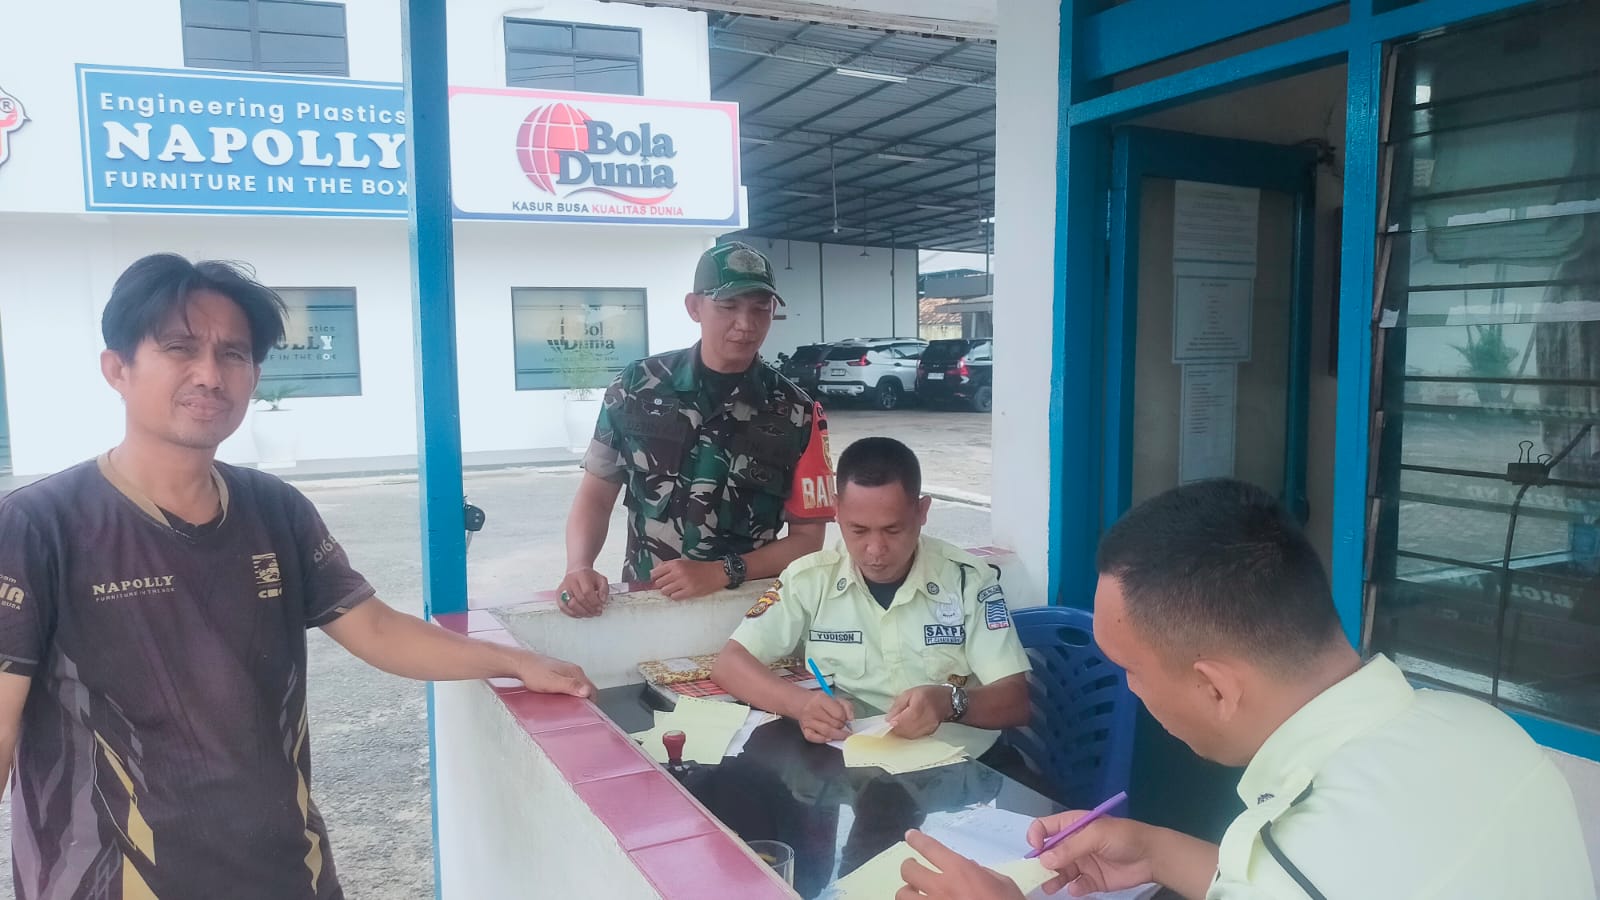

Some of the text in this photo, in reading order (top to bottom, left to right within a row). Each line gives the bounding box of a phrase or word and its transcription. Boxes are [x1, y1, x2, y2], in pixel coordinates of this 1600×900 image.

[100, 92, 406, 125] Engineering Plastics
[102, 121, 406, 169] NAPOLLY
[584, 119, 677, 158] Bola
[105, 171, 408, 196] FURNITURE IN THE BOX
[555, 150, 677, 189] Dunia
[512, 201, 684, 216] KASUR BUSA KUALITAS DUNIA
[92, 575, 175, 596] NAPOLLY
[926, 626, 966, 638] SATPA
